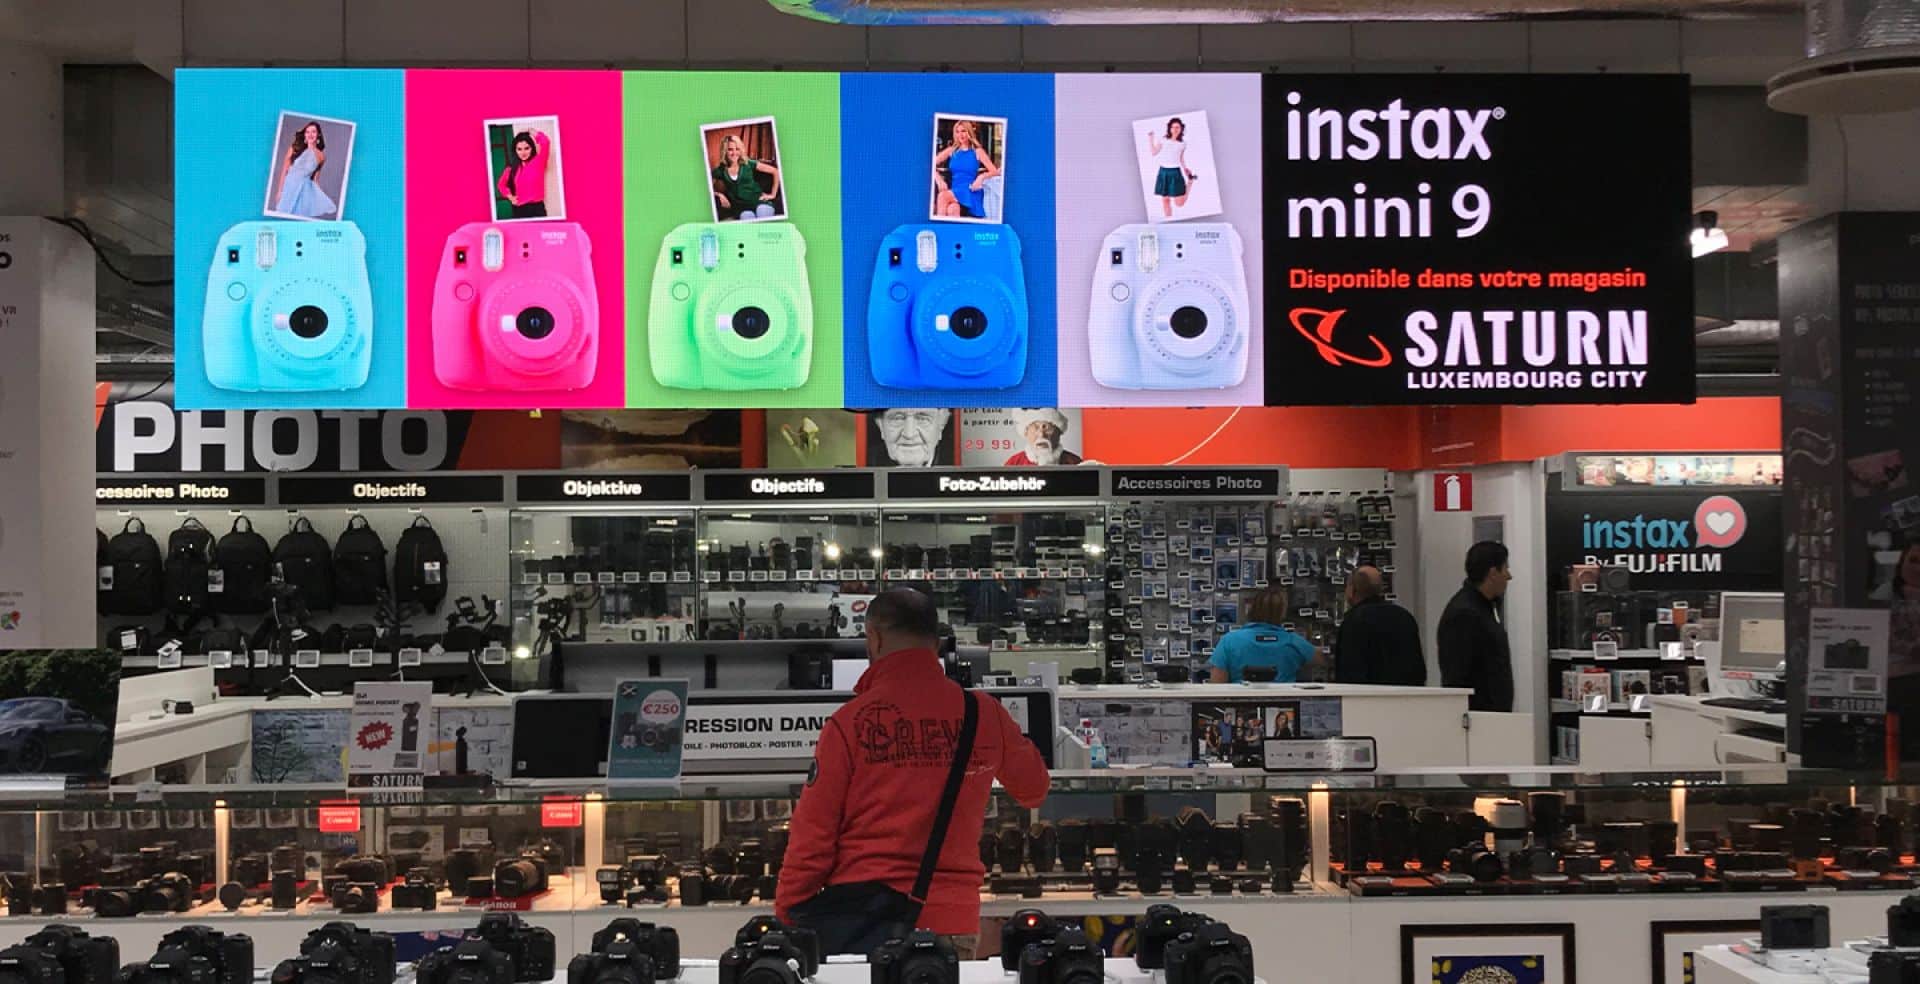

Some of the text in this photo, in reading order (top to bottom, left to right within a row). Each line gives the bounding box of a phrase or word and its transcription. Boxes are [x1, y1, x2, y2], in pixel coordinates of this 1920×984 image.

[1288, 182, 1490, 238] mini 9
[1290, 267, 1646, 293] Disponible dans votre magasin
[1405, 310, 1648, 367] SATURN
[1407, 371, 1647, 389] LUXEMBOURG CITY
[114, 400, 448, 472] PHOTO
[96, 483, 229, 498] cessoires Photo
[353, 482, 426, 498] Objectifs
[563, 480, 642, 498] Objektive
[751, 478, 825, 496] Objectifs
[939, 476, 1046, 493] Foto-Zubehör
[1118, 475, 1262, 491] Accessoires Photo
[1583, 514, 1690, 549] instax
[1614, 553, 1722, 573] FUJIFILM
[643, 704, 679, 715] €250
[684, 717, 773, 733] RESSION
[710, 741, 762, 749] PHOTOBLOX
[768, 740, 803, 748] POSTER
[372, 775, 425, 788] SATURN
